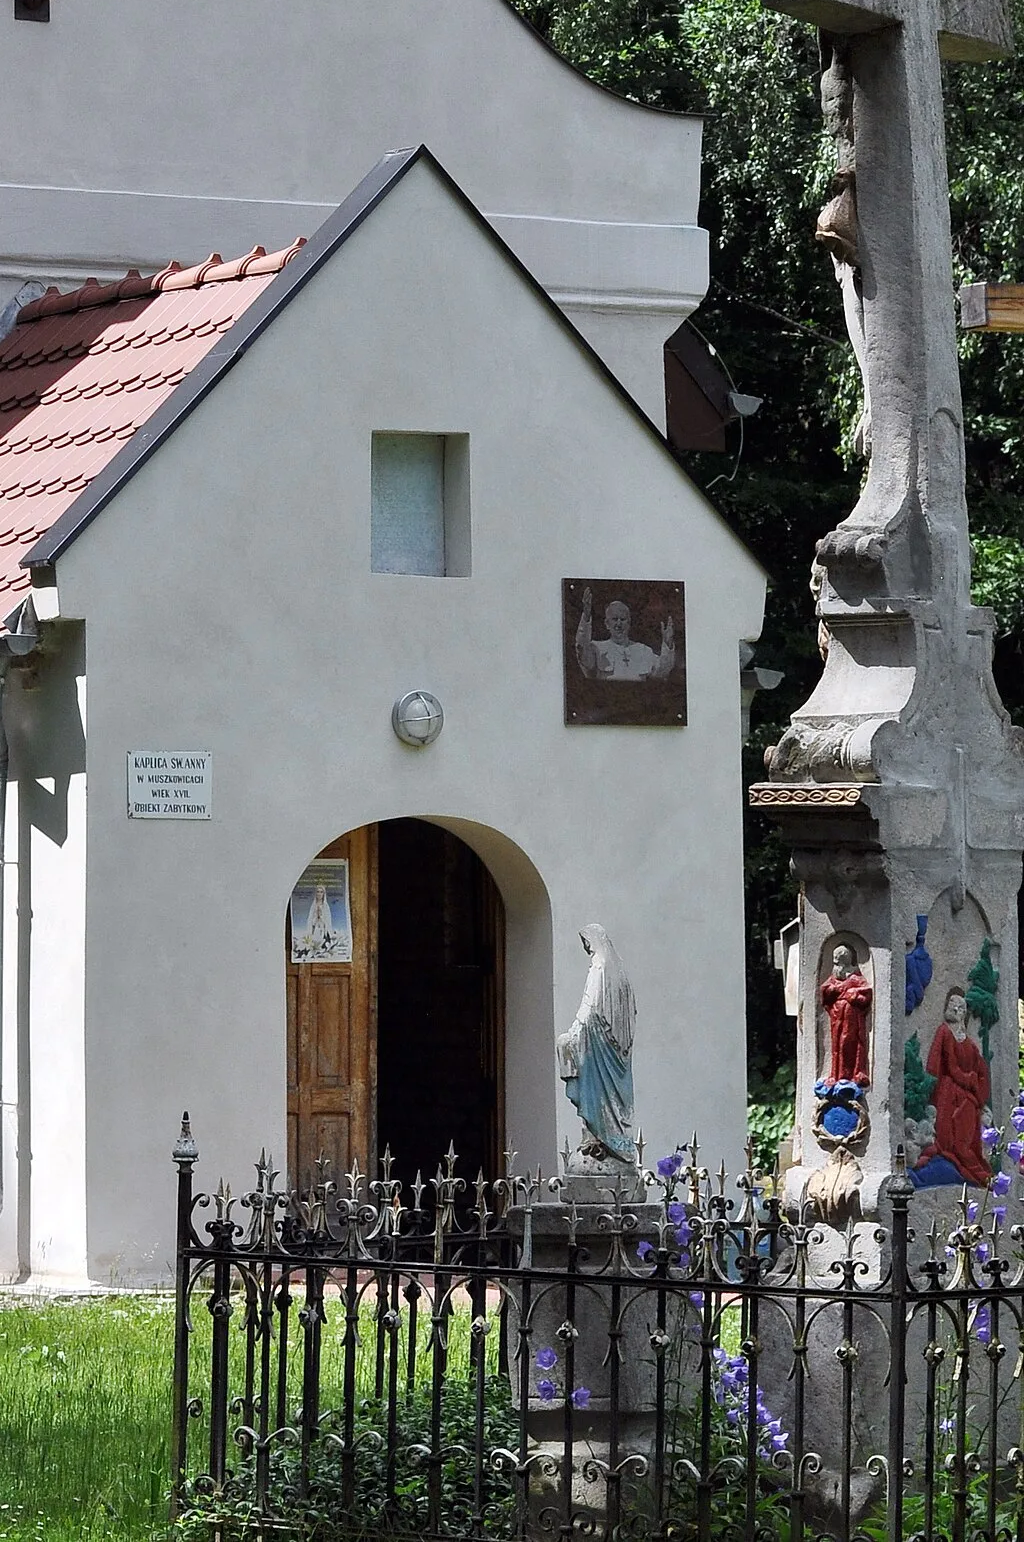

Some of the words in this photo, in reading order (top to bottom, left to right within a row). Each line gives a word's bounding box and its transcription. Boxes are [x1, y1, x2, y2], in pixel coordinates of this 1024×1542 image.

[134, 757, 168, 769] KAPLICA
[137, 774, 144, 784] W
[147, 774, 204, 784] MUSZKOWICACH
[151, 789, 171, 798] WIEK
[134, 803, 160, 813] OBIEKT
[163, 803, 207, 814] ZABYTKOWY
